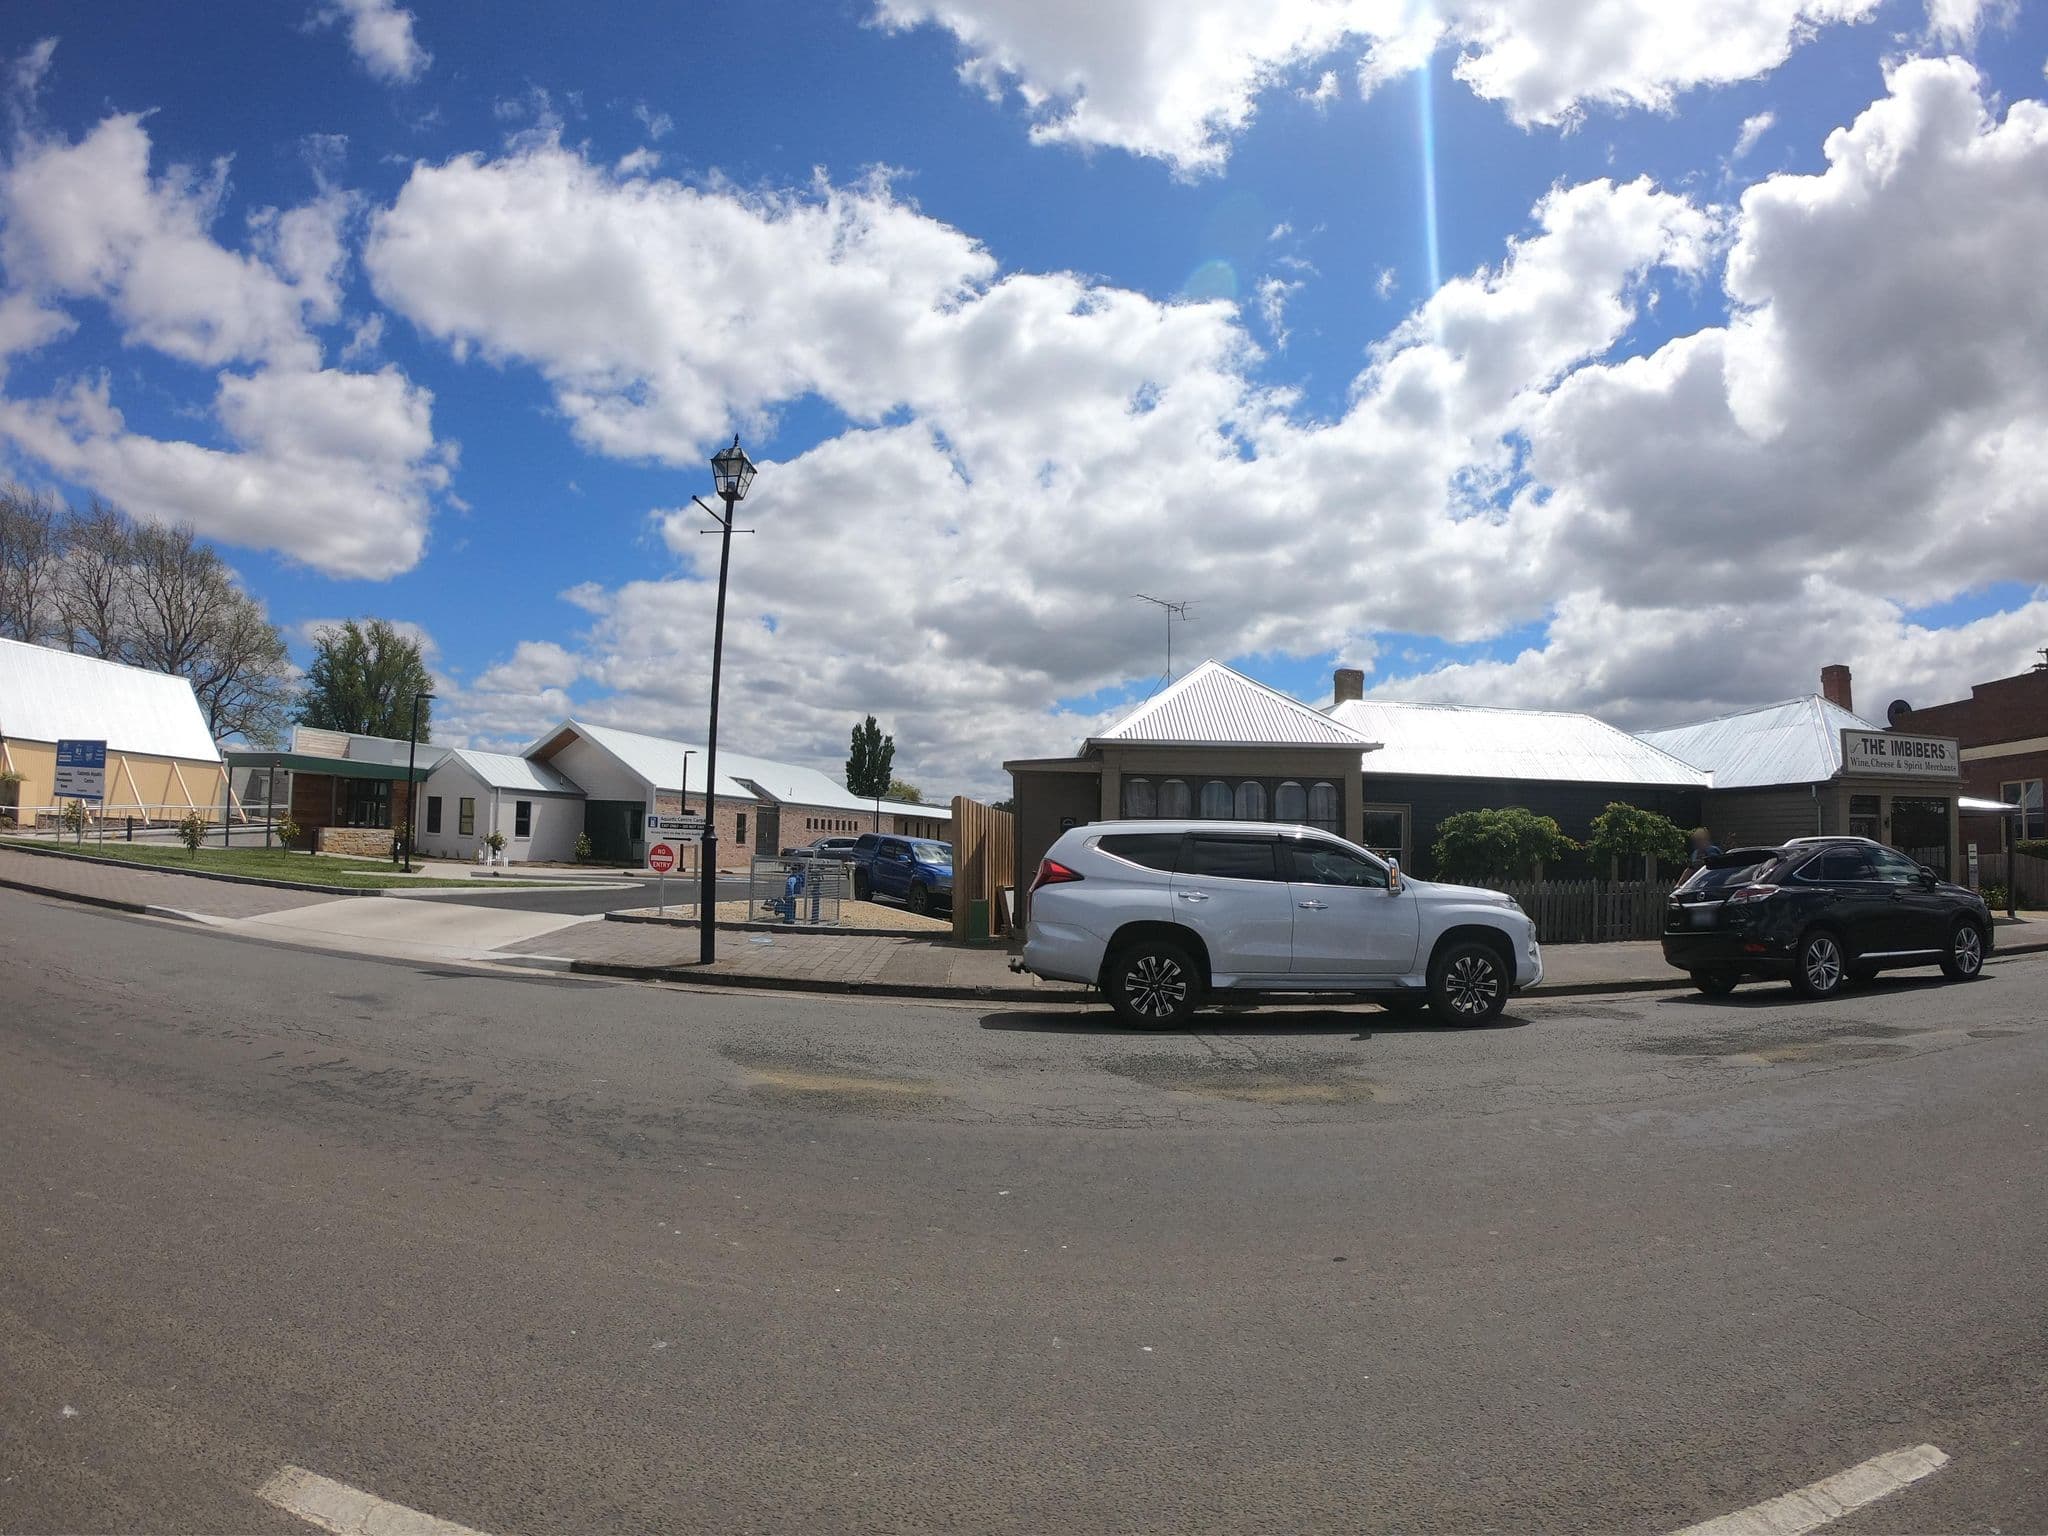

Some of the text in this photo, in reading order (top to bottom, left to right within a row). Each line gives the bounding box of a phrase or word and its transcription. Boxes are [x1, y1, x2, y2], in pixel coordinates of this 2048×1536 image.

[1861, 738, 1946, 760] THE IMBIBERS
[1850, 757, 1956, 772] Wine, Cheese & Spirit Merchants
